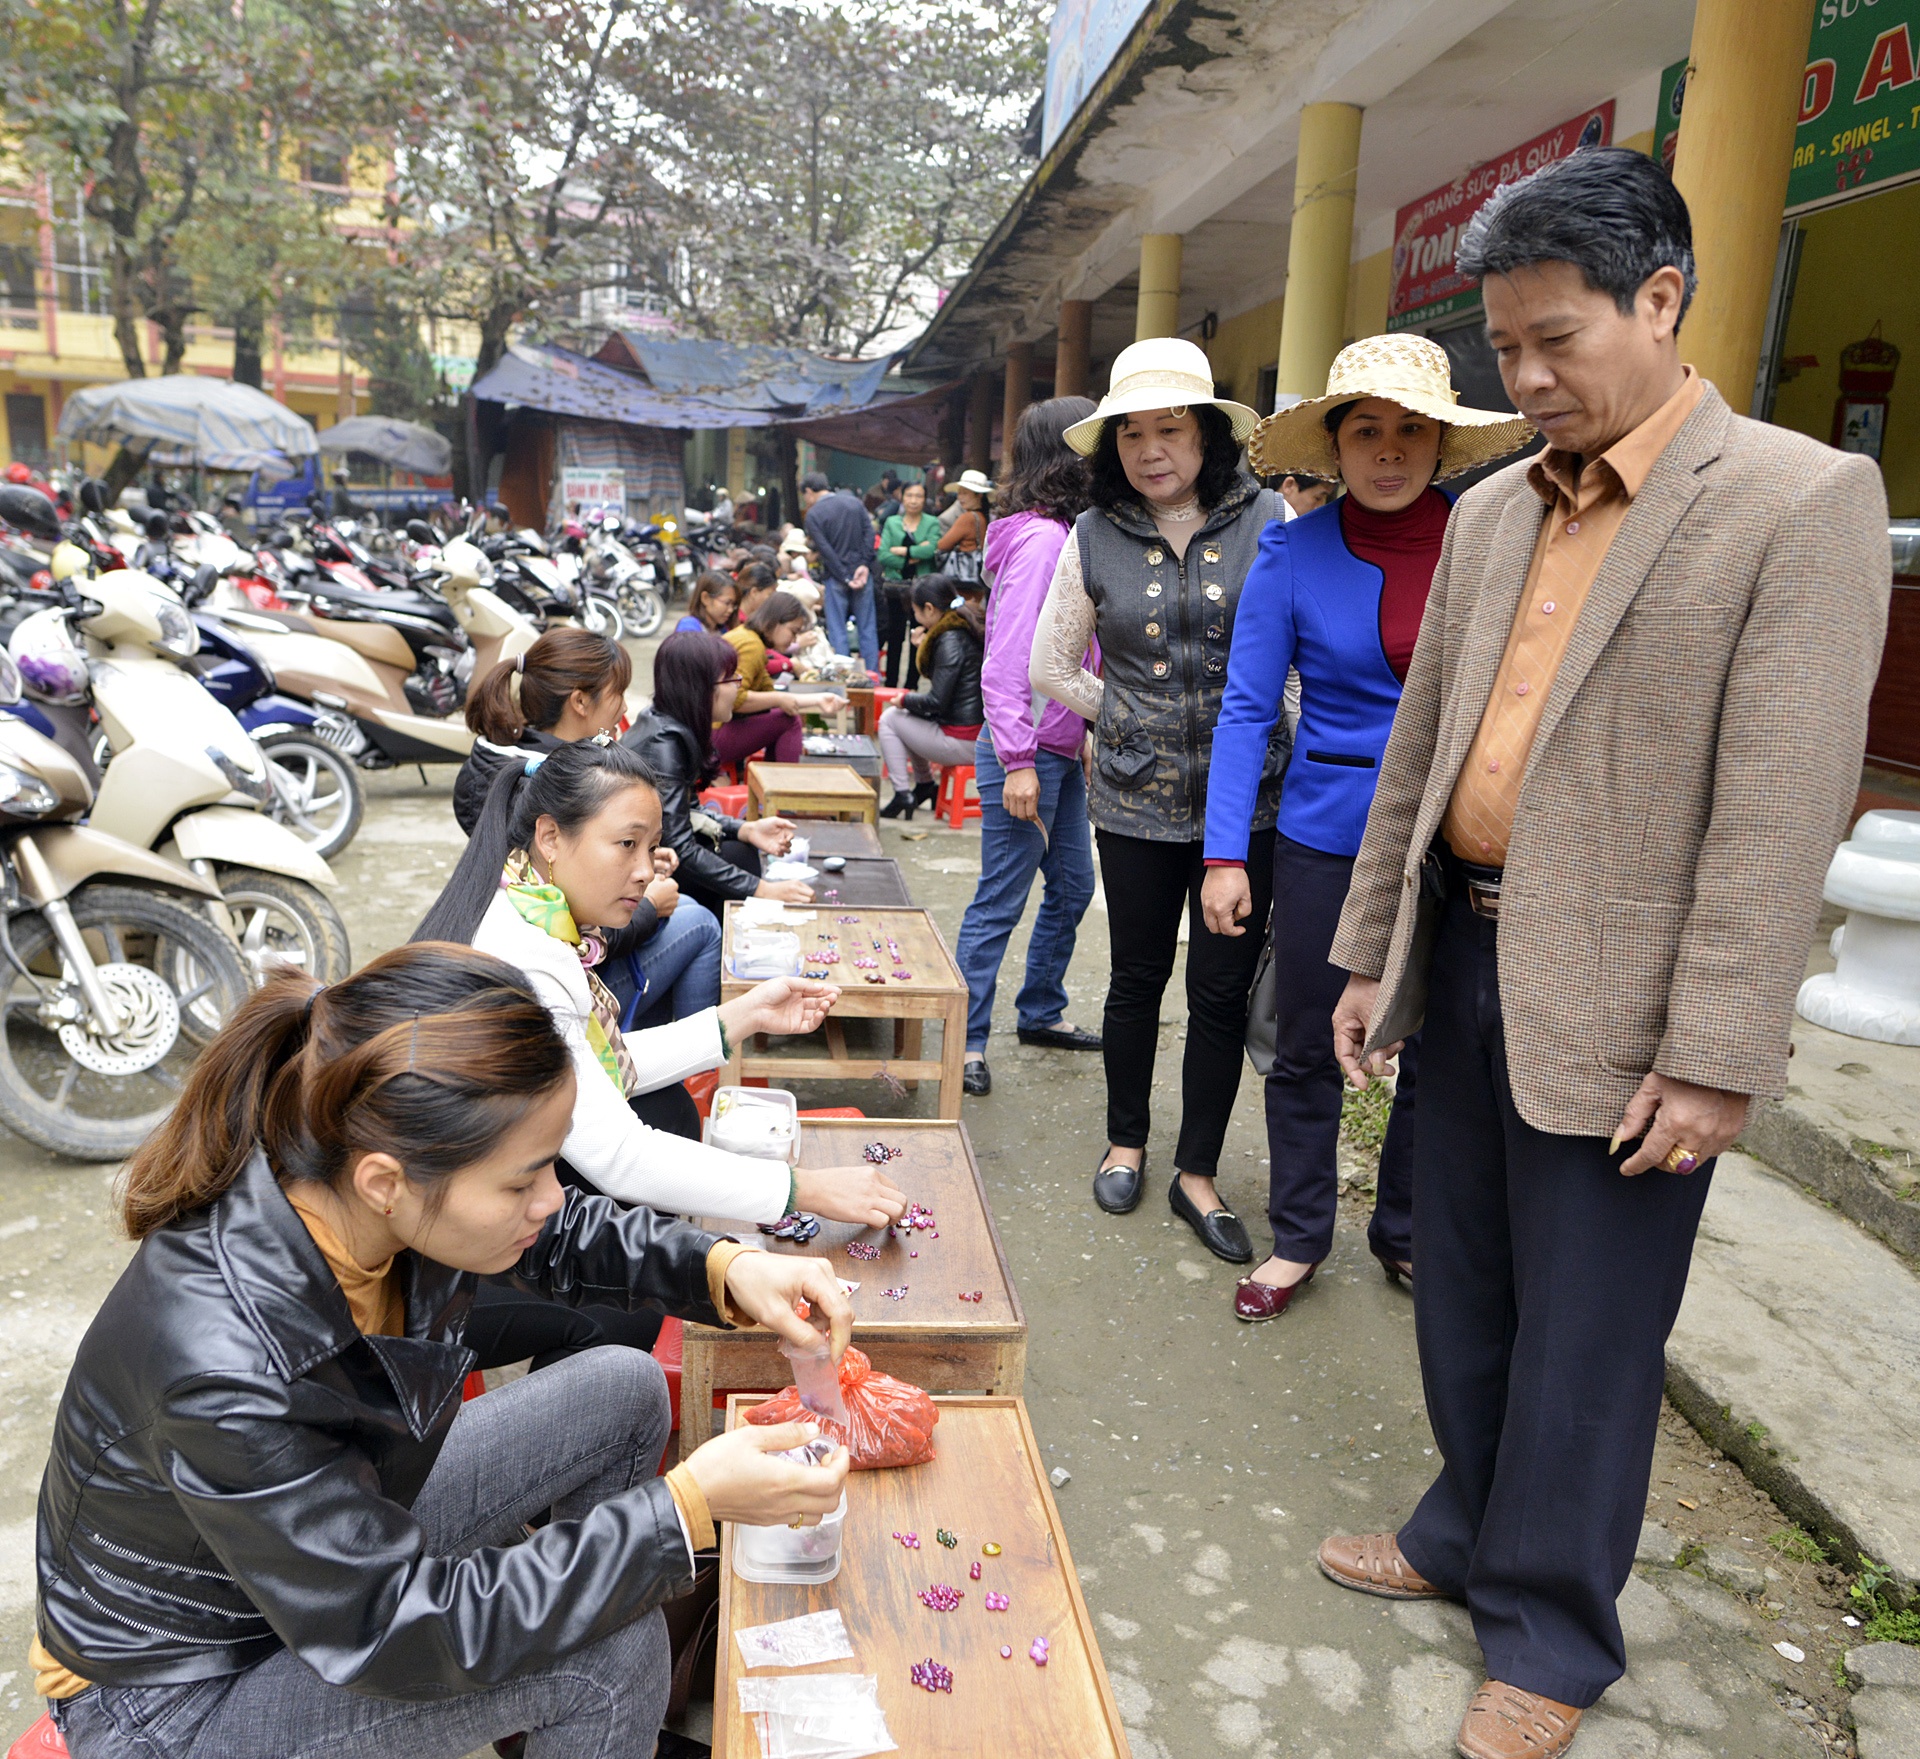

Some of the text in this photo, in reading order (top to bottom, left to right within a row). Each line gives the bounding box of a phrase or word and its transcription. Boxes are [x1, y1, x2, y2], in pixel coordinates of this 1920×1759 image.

[1853, 22, 1920, 105] A
[1423, 185, 1465, 219] TRANG
[1466, 168, 1496, 200] SỨC
[1525, 129, 1565, 170] QUÝ
[1830, 116, 1892, 157] SPINEL
